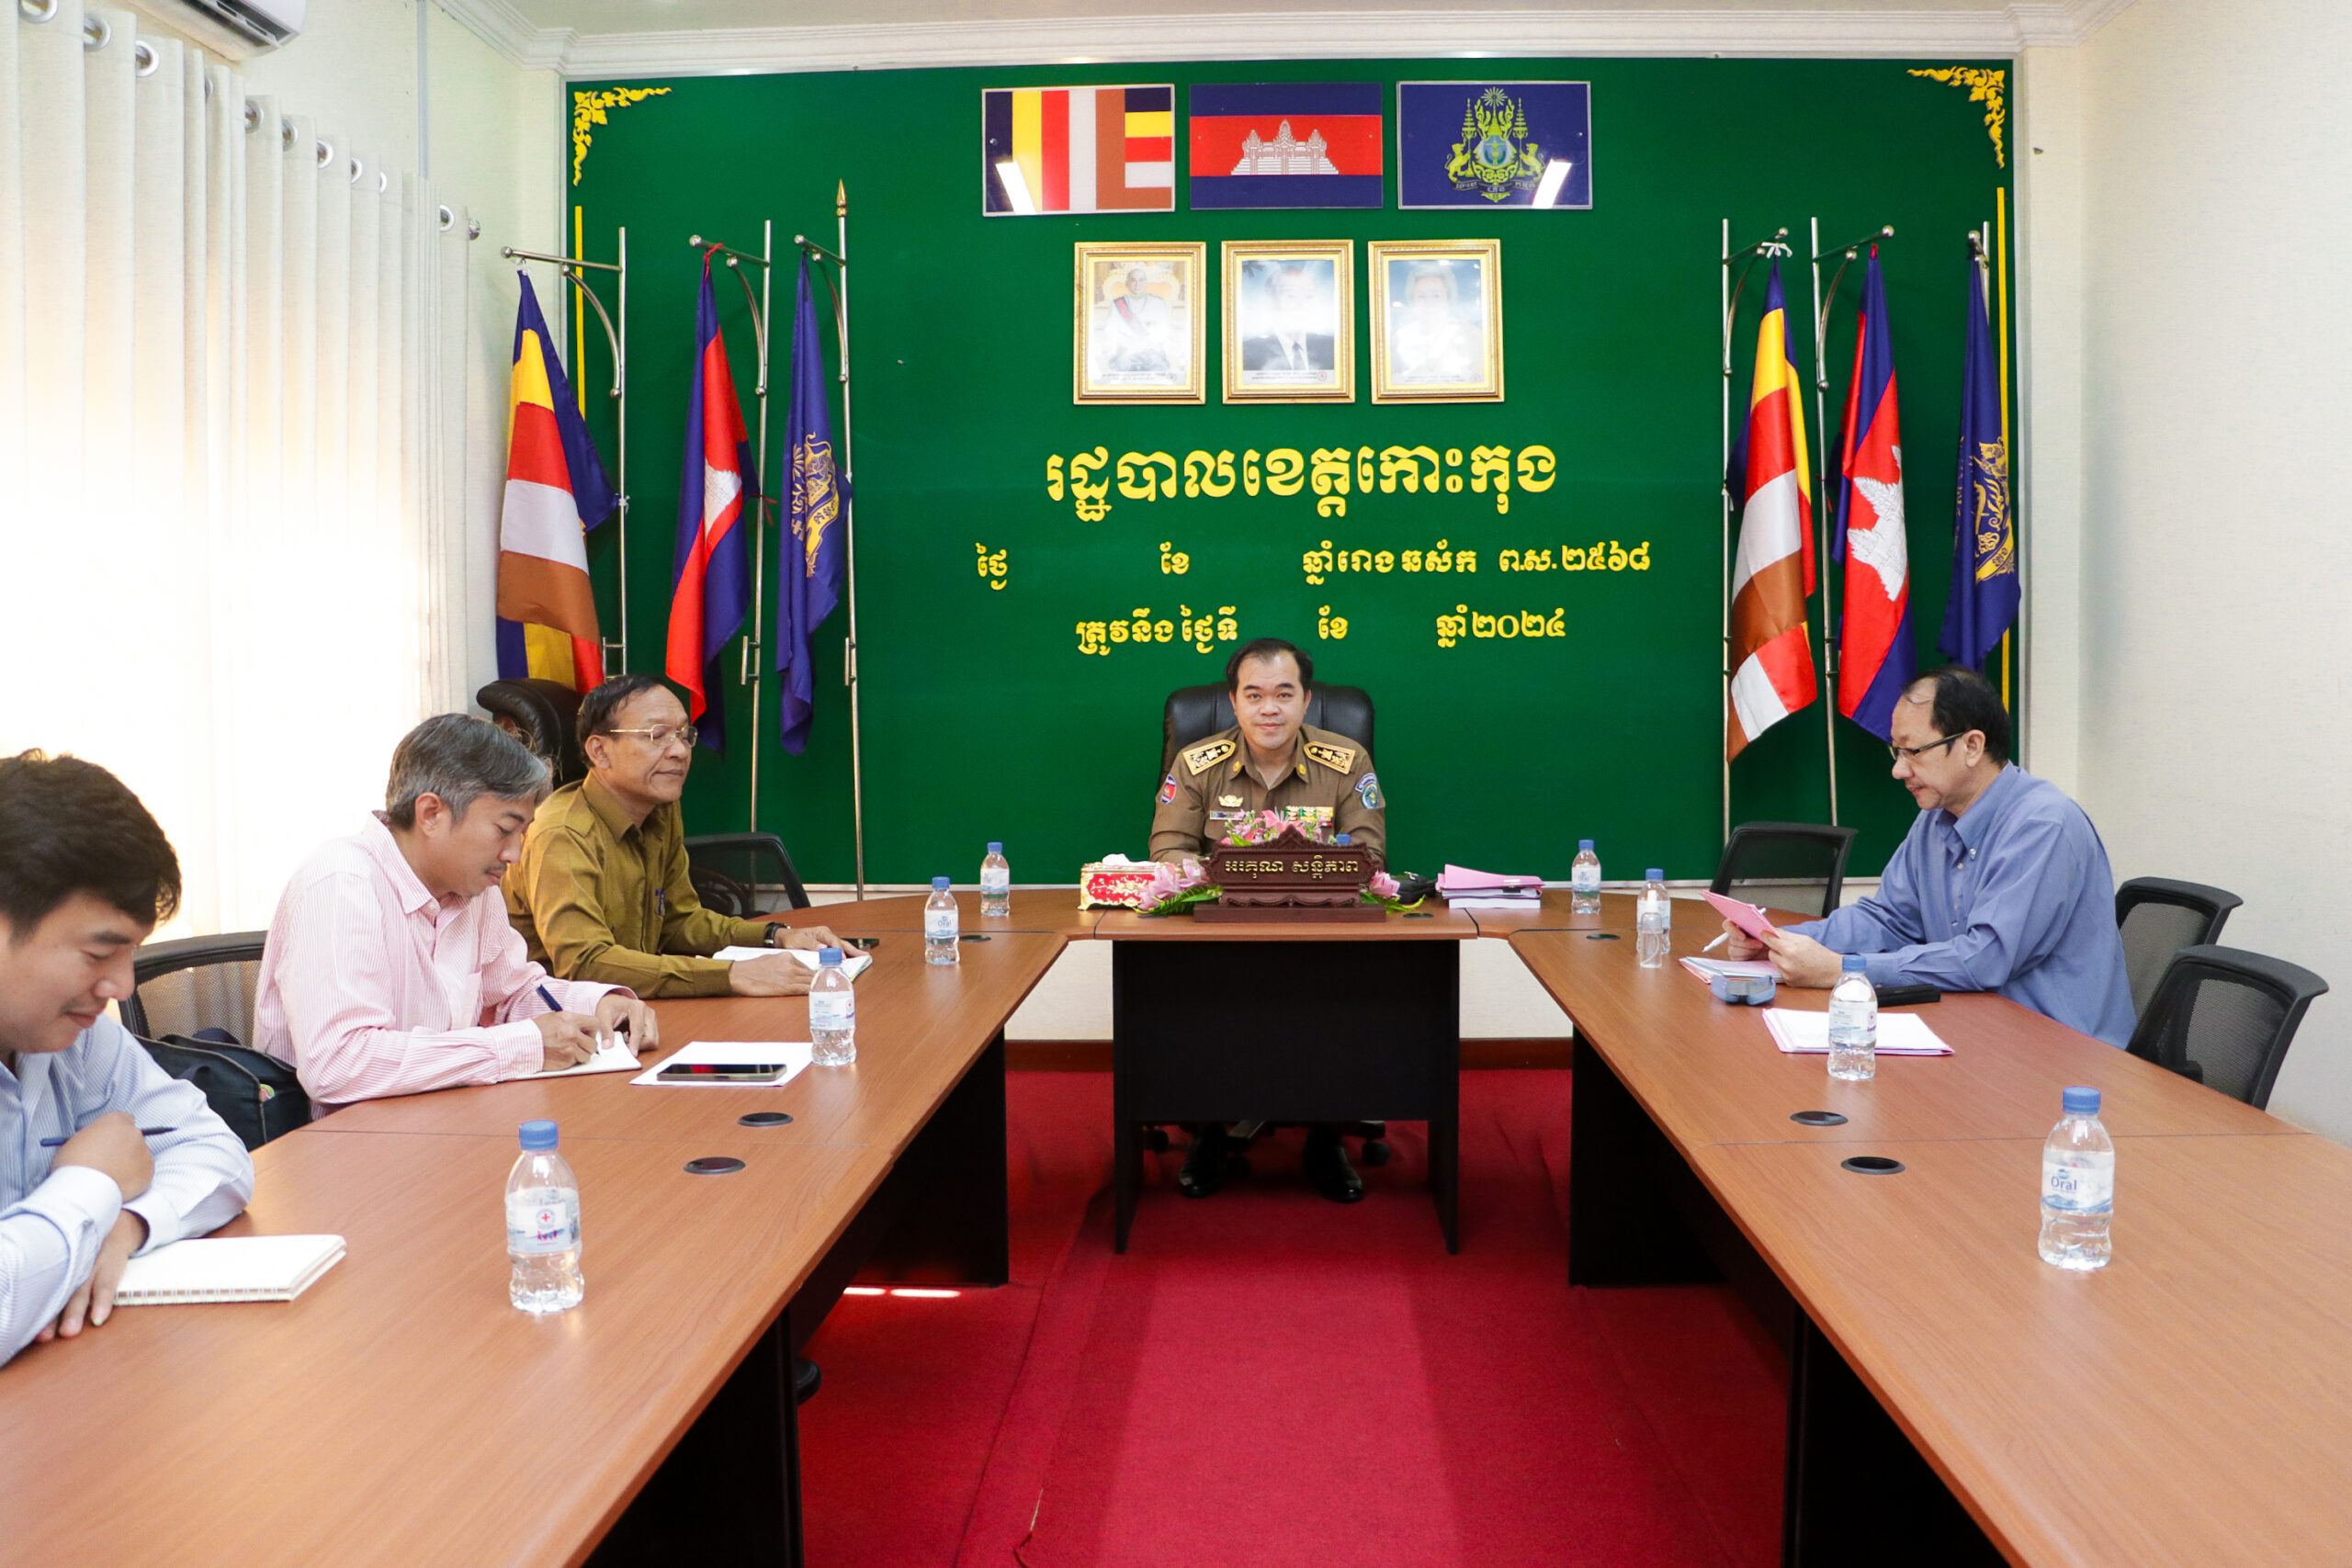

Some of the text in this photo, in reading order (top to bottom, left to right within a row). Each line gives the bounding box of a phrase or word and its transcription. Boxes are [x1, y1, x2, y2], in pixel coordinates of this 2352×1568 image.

[1046, 445, 1557, 523] រដ្ឋបាលខេត្តកោះកុង
[975, 541, 1009, 591] ថ្ងៃ
[1159, 540, 1191, 575] ខែ
[1179, 604, 1238, 655] ថ្ងៃទី
[1317, 604, 1350, 641] ខែ
[1291, 854, 1360, 879] សន្តិភាព
[2051, 1175, 2077, 1191] Oral
